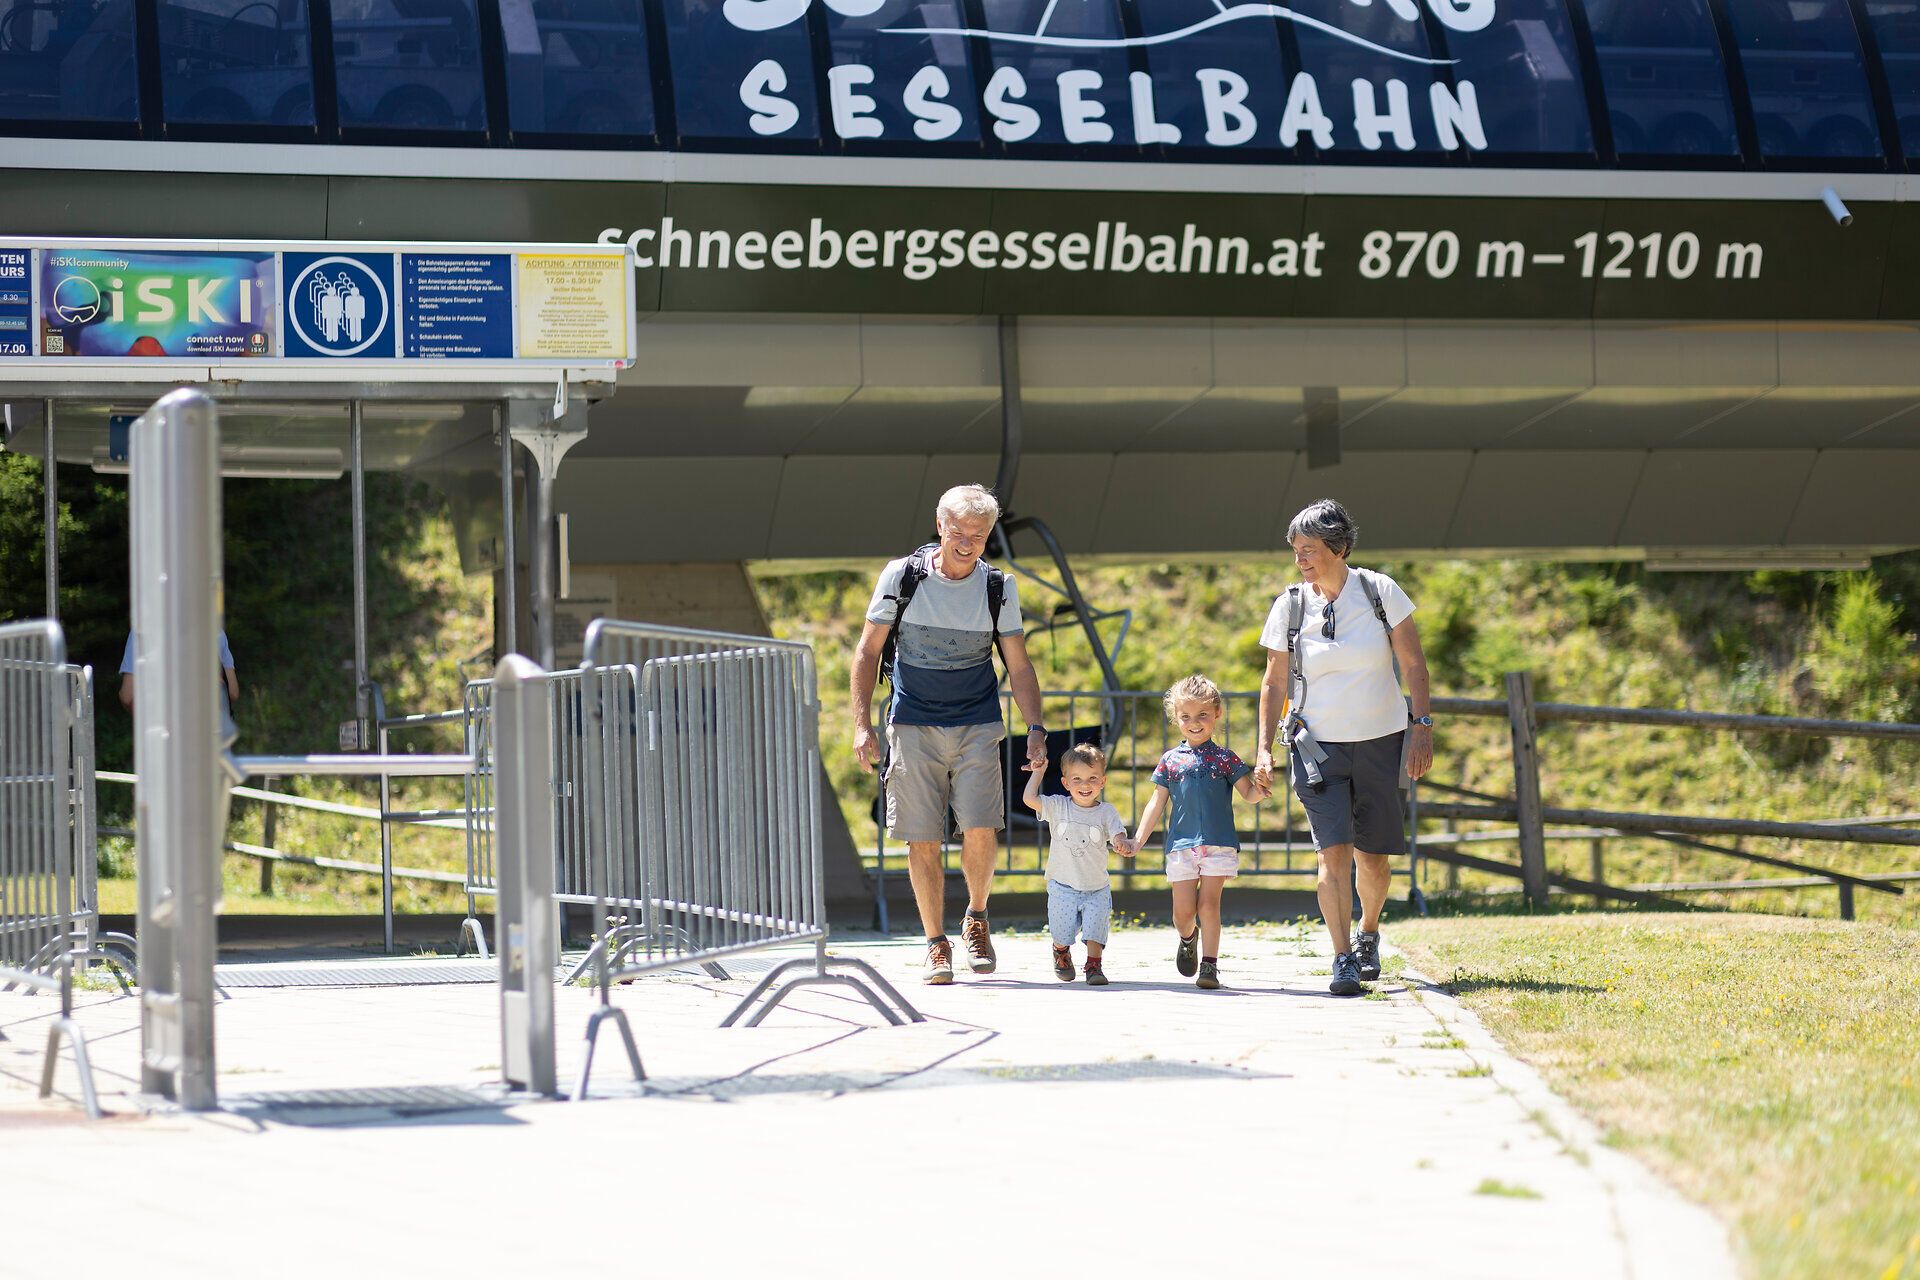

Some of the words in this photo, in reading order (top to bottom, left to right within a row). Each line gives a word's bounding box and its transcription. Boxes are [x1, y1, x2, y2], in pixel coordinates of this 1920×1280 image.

[739, 59, 1488, 151] SESSELBAHN
[50, 257, 129, 270] #iSKIcommunity
[1358, 230, 1460, 280] 870
[1715, 241, 1764, 280] m
